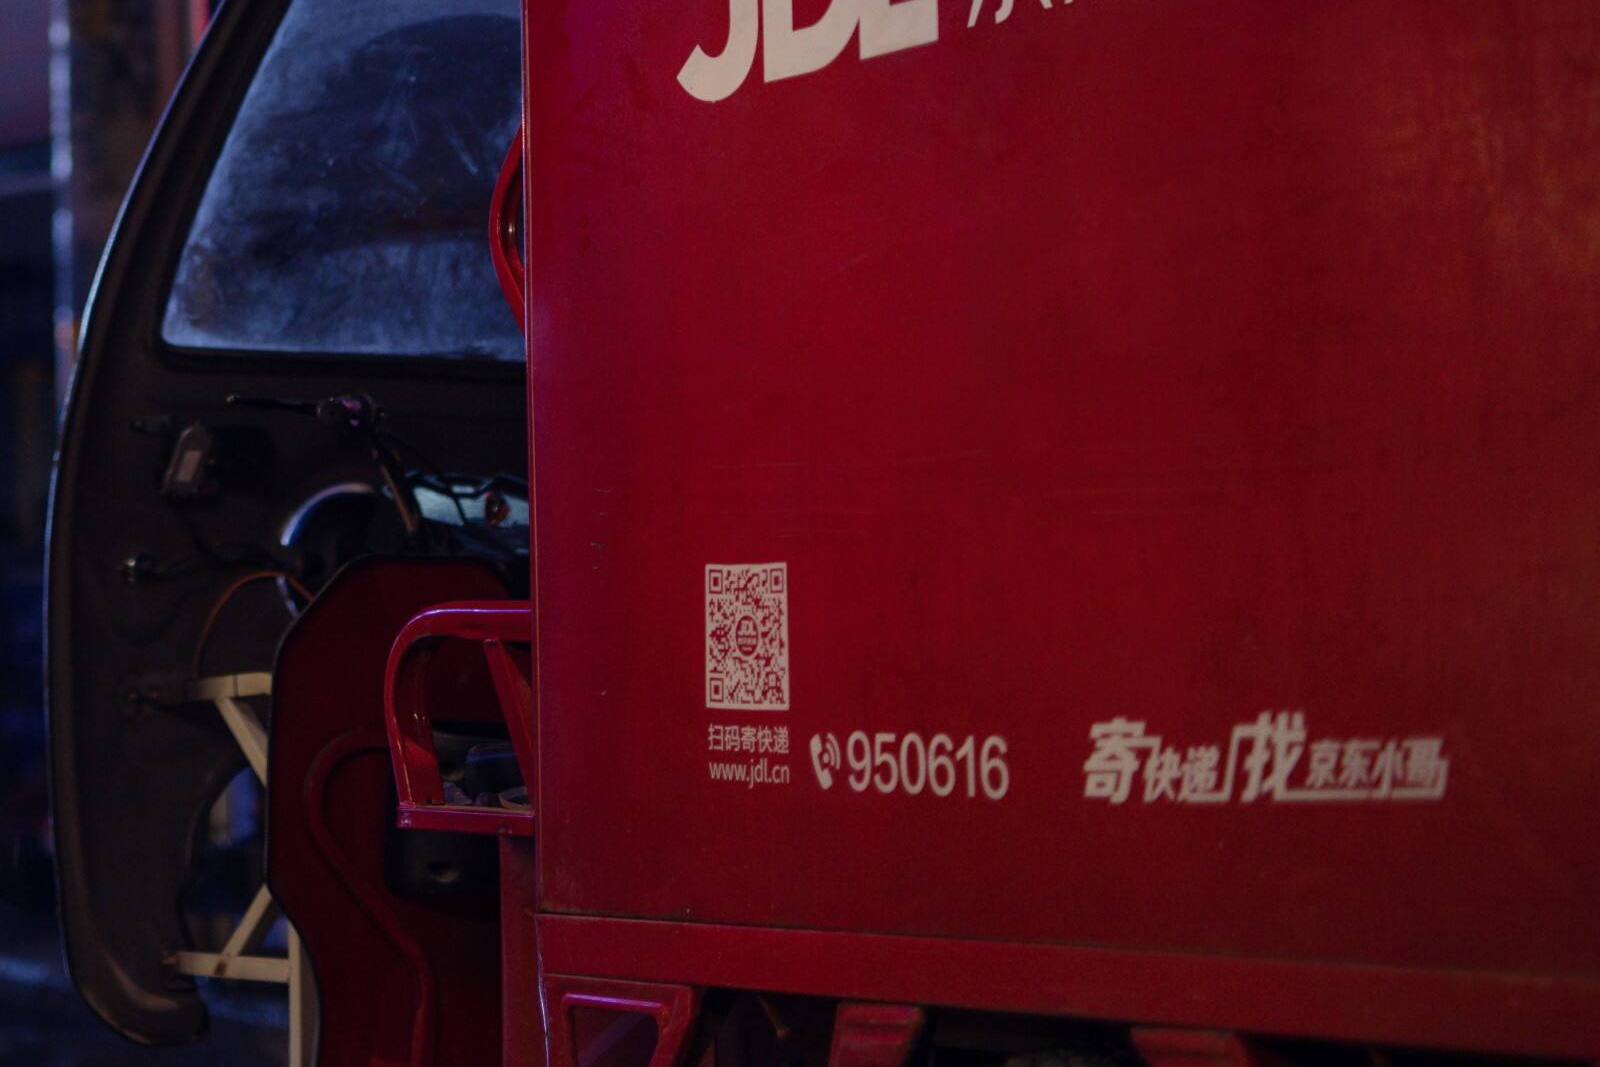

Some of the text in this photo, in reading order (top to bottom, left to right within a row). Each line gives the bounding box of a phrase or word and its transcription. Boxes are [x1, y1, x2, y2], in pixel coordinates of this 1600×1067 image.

[707, 724, 790, 755] 扫码寄快递
[708, 757, 791, 790] www.jdl.cn
[846, 730, 1010, 801] 950616
